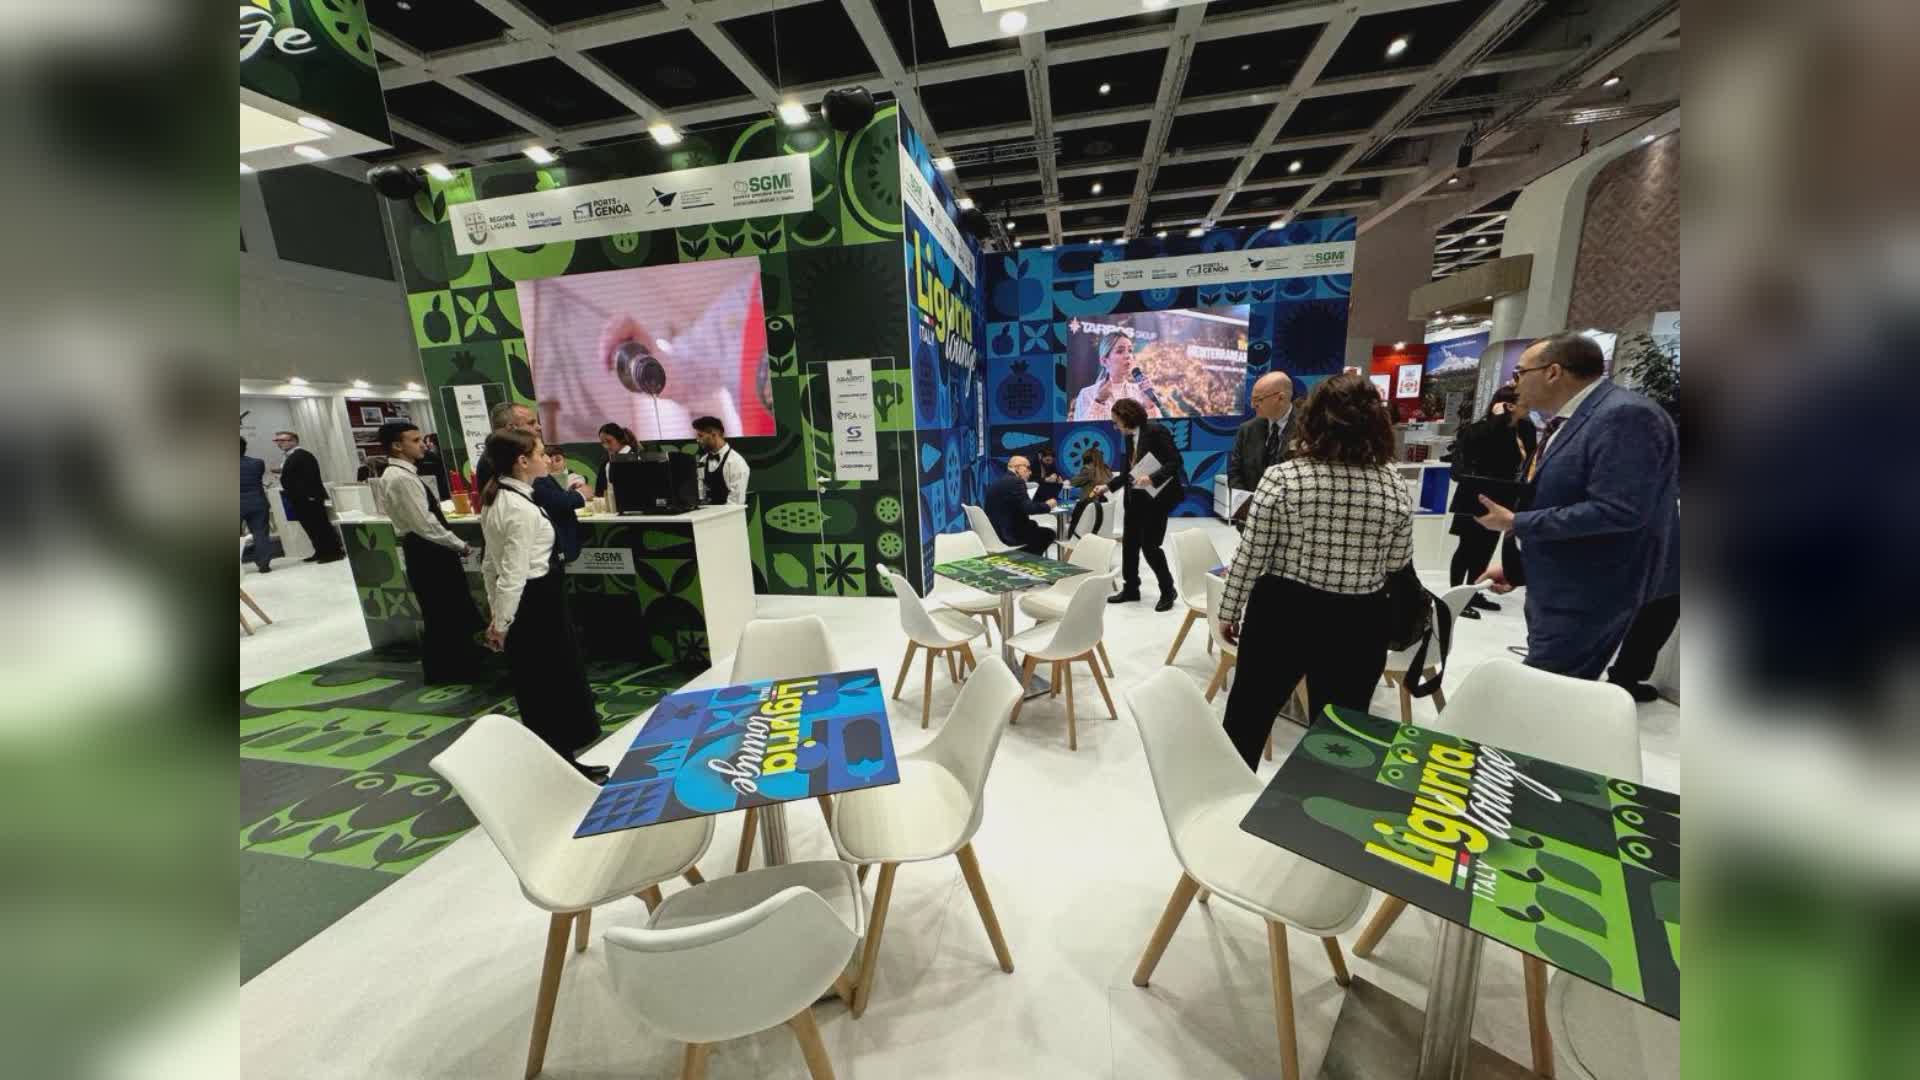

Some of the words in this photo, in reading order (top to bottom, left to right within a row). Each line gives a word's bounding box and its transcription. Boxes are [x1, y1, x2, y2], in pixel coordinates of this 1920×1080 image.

[489, 213, 515, 223] REGIONE
[490, 221, 516, 231] LIGURIA
[593, 197, 617, 208] PORTS
[594, 203, 632, 217] GENOA
[914, 230, 972, 343] Liguria
[1202, 265, 1229, 274] GENOA
[945, 312, 977, 398] lounge
[708, 715, 786, 795] lounge
[761, 680, 818, 776] Liguria
[1365, 743, 1489, 885] Liguria
[1435, 744, 1562, 839] lounge
[1473, 859, 1497, 902] ITALY
